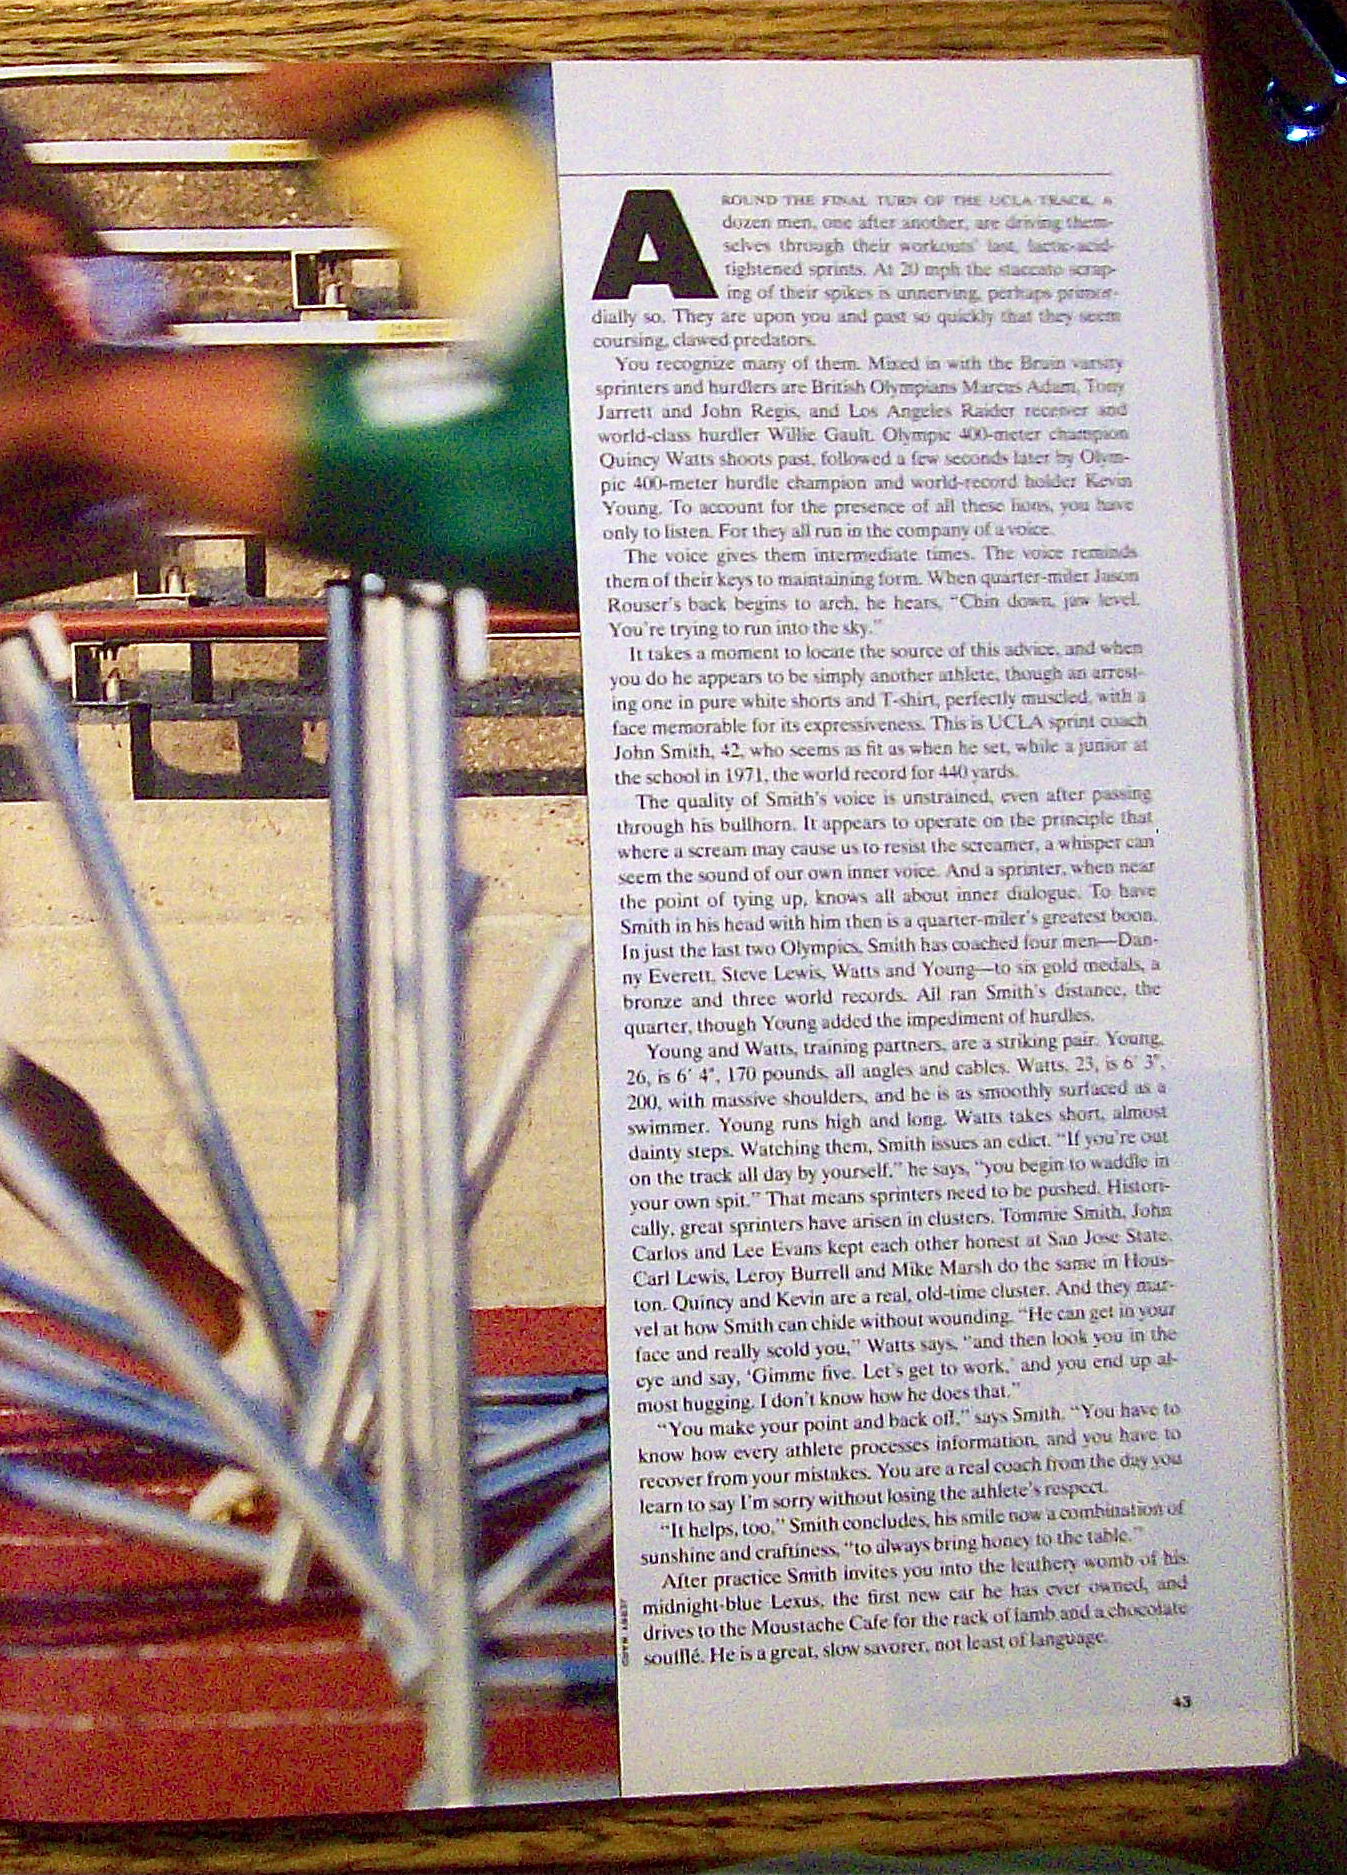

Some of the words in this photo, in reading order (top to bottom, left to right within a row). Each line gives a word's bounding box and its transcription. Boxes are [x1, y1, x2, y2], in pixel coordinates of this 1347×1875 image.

[721, 214, 772, 230] dozen
[591, 189, 720, 300] A
[779, 237, 845, 257] through
[724, 260, 803, 280] tightened
[824, 284, 874, 304] spikes
[591, 307, 637, 327] dially
[673, 307, 714, 327] They
[672, 332, 730, 348] clawed
[616, 355, 650, 371] You
[655, 355, 736, 375] recognize
[595, 379, 669, 398] sprinters
[708, 379, 778, 394] hurdlers
[811, 378, 867, 394] British
[869, 378, 958, 398] Olympians
[598, 403, 653, 418] Jarrett
[886, 402, 953, 422] Angeles
[598, 427, 692, 443] world-class
[698, 426, 760, 442] hurdler
[767, 426, 817, 442] Willie
[598, 450, 660, 470] Quincy
[666, 450, 715, 466] Watts
[719, 450, 773, 466] shoots
[820, 450, 892, 466] followed
[633, 474, 718, 490] 400-meter
[725, 474, 780, 490] hurdle
[786, 474, 868, 494] champion
[699, 499, 764, 515] account
[833, 501, 906, 518] presence
[602, 523, 639, 543] only
[895, 525, 970, 541] company
[665, 547, 708, 563] voice
[813, 546, 918, 562] intermediate
[605, 572, 649, 588] them
[673, 571, 713, 587] their
[777, 570, 875, 590] maintaining
[687, 596, 727, 612] back
[734, 595, 788, 615] begins
[669, 620, 719, 641] trying
[775, 619, 809, 635] into
[647, 645, 692, 661] takes
[710, 644, 780, 660] moment
[697, 673, 763, 689] appears
[869, 666, 934, 683] another
[741, 693, 787, 709] white
[791, 692, 841, 708] shorts
[612, 719, 647, 735] face
[651, 718, 747, 734] memorable
[614, 743, 655, 759] John
[789, 745, 840, 757] seems
[645, 768, 701, 784] school
[854, 764, 908, 780] record
[637, 793, 670, 808] The
[676, 792, 734, 812] quality
[616, 818, 685, 838] through
[822, 818, 887, 835] appears
[617, 843, 669, 860] where
[687, 846, 748, 859] scream
[618, 872, 662, 885] seem
[698, 866, 749, 883] sound
[654, 892, 699, 913] point
[732, 891, 775, 911] tying
[620, 917, 671, 933] Smith
[723, 915, 765, 931] head
[644, 943, 675, 963] just
[711, 941, 741, 957] last
[721, 965, 767, 982] Steve
[832, 962, 880, 979] Watts
[622, 993, 682, 1010] bronze
[732, 990, 777, 1007] three
[696, 1016, 757, 1037] though
[762, 1014, 817, 1035] Young
[647, 1042, 703, 1063] Young
[803, 1038, 869, 1059] training
[728, 1066, 757, 1082] 170
[862, 1062, 914, 1083] angles
[668, 1092, 706, 1108] with
[711, 1090, 777, 1107] massive
[719, 1116, 774, 1137] Young
[781, 1118, 819, 1131] runs
[628, 1144, 681, 1164] dainty
[740, 1139, 821, 1161] Watching
[656, 1169, 684, 1185] the
[689, 1167, 732, 1184] track
[630, 1198, 669, 1215] your
[869, 1185, 942, 1207] sprinters
[680, 1218, 723, 1239] great
[729, 1215, 804, 1237] sprinters
[631, 1245, 688, 1262] Carlos
[771, 1240, 822, 1257] Evans
[632, 1271, 670, 1287] Carl
[736, 1266, 784, 1287] Leroy
[791, 1264, 850, 1281] Burrell
[672, 1293, 734, 1315] Quincy
[776, 1290, 825, 1307] Kevin
[723, 1317, 774, 1334] Smith
[860, 1311, 924, 1329] without
[635, 1346, 670, 1363] face
[714, 1343, 761, 1364] really
[766, 1341, 811, 1358] scold
[635, 1376, 664, 1393] eye
[671, 1371, 704, 1387] and
[636, 1396, 678, 1413] most
[819, 1389, 865, 1406] know
[709, 1418, 755, 1435] make
[803, 1415, 848, 1436] point
[637, 1446, 685, 1464] know
[733, 1447, 779, 1464] every
[785, 1440, 844, 1458] athlete
[850, 1440, 930, 1459] processes
[639, 1475, 702, 1489] recover
[706, 1469, 748, 1486] from
[639, 1497, 684, 1515] learn
[772, 1495, 815, 1513] sorry
[818, 1488, 883, 1507] without
[789, 1515, 839, 1533] Smith
[933, 1510, 958, 1527] his
[640, 1546, 716, 1565] sunshine
[875, 1536, 931, 1558] always
[662, 1571, 707, 1588] After
[713, 1568, 782, 1590] practice
[843, 1563, 898, 1581] invites
[642, 1595, 762, 1620] midnight-blue
[867, 1588, 900, 1605] first
[642, 1623, 694, 1640] drives
[751, 1616, 845, 1635] Moustache
[643, 1647, 705, 1666] soufflé.
[822, 1640, 860, 1658] slow
[1172, 1694, 1192, 1708] 43
